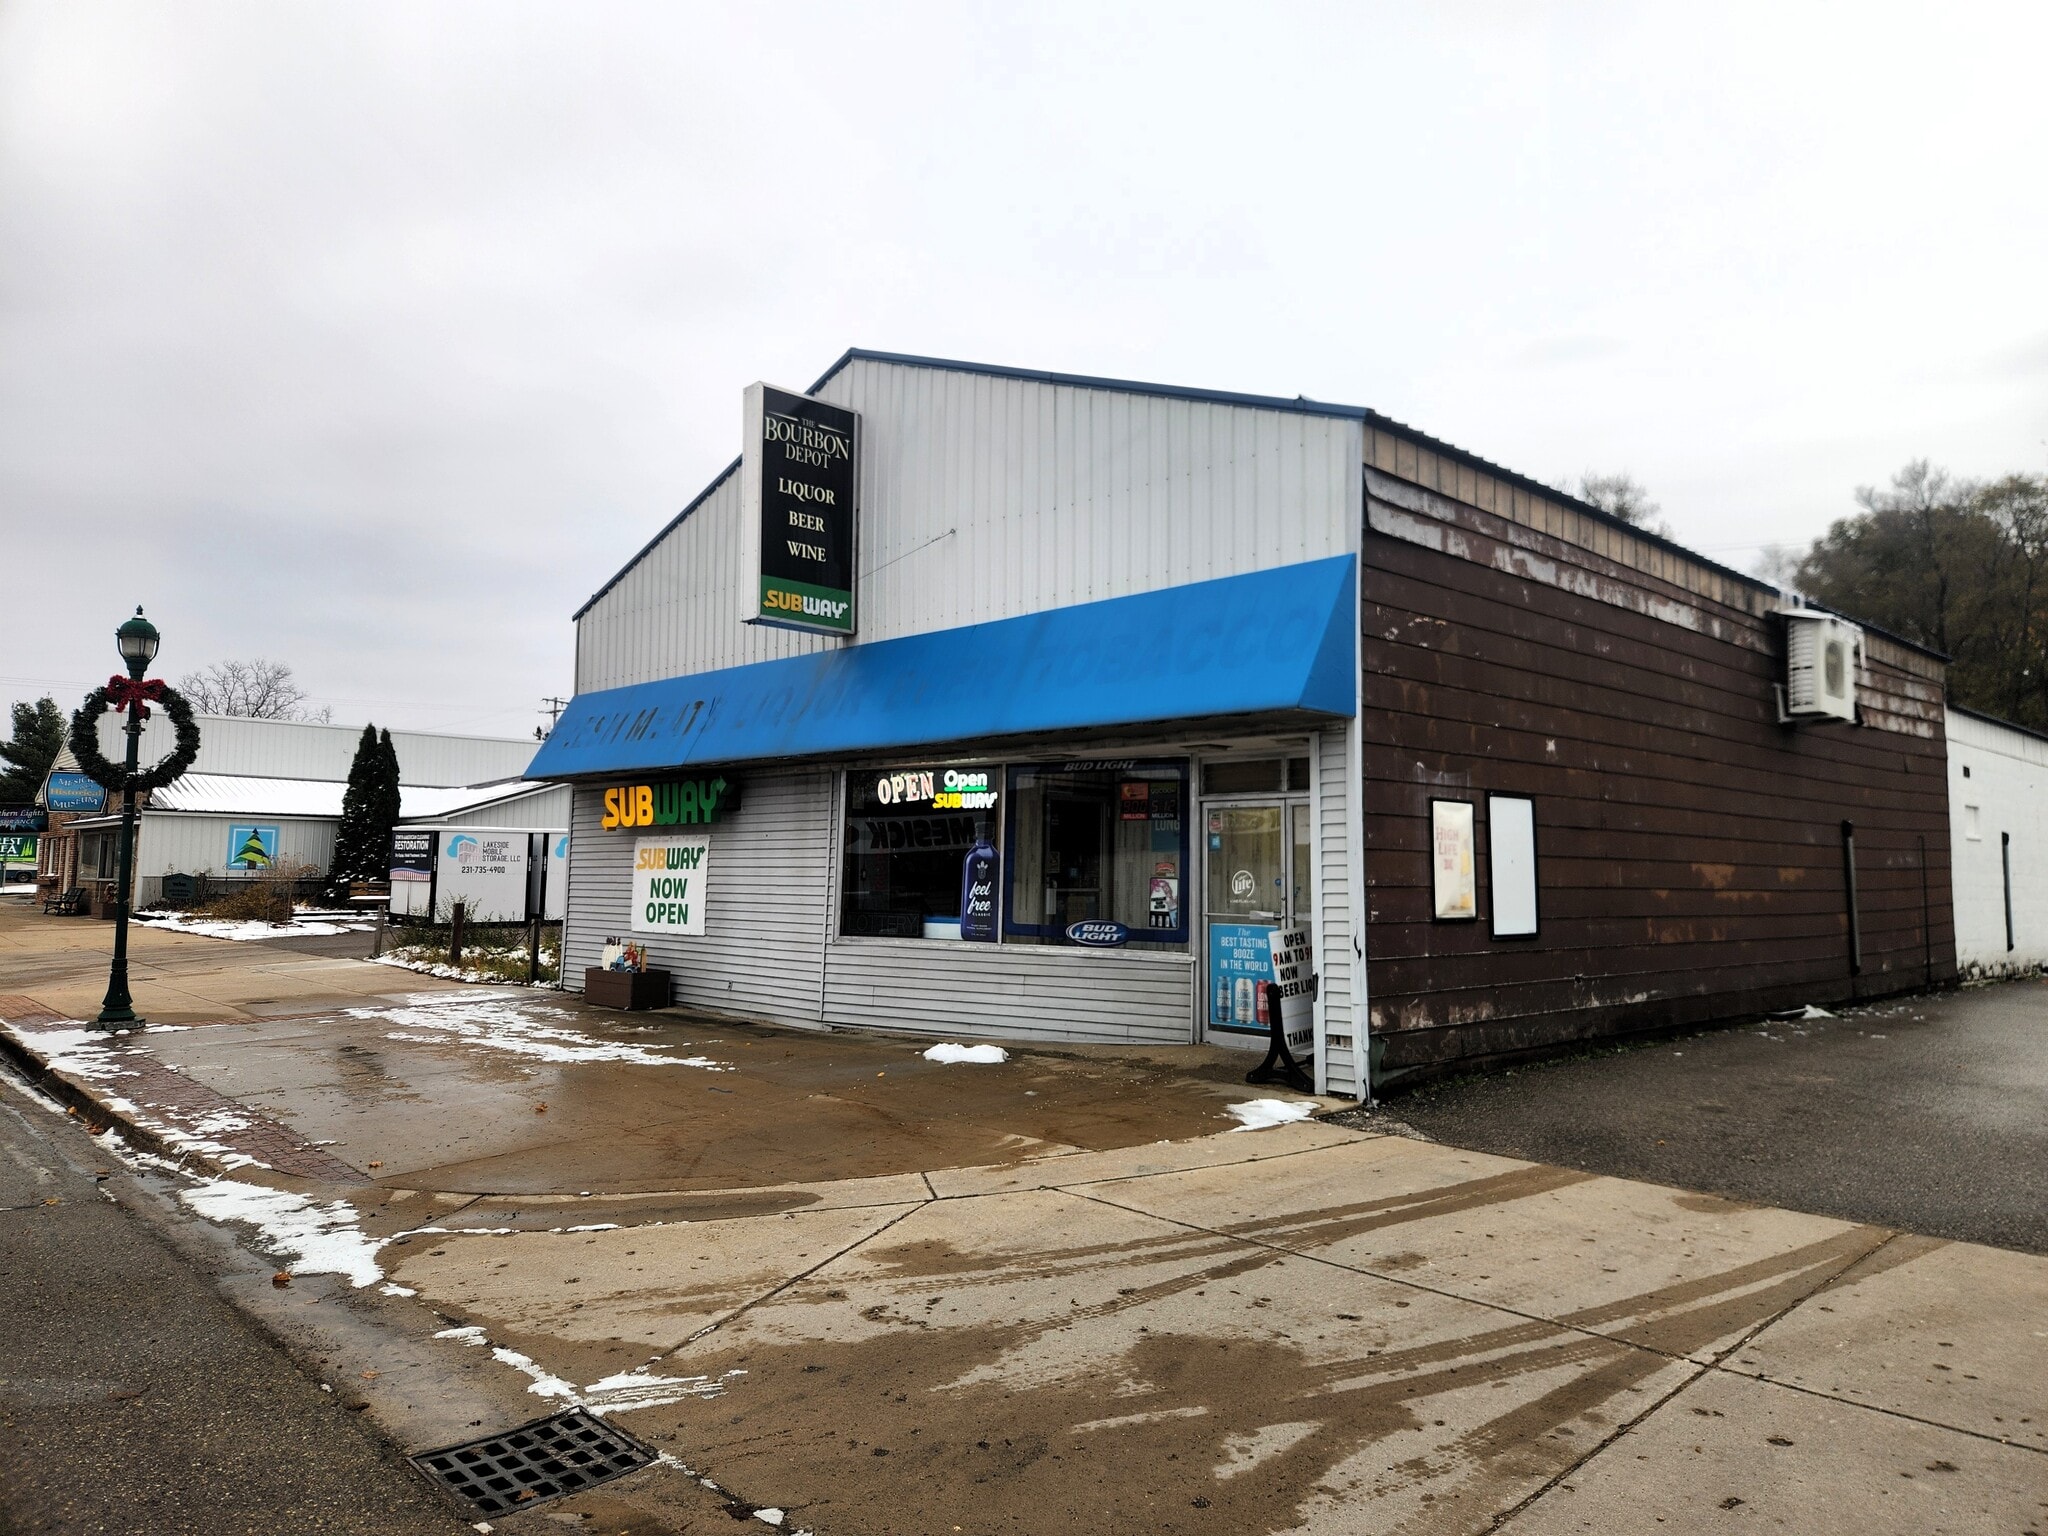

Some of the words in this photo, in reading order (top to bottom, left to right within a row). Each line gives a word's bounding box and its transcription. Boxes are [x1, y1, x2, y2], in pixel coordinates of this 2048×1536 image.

[801, 418, 816, 428] THE
[764, 416, 850, 461] BOURBON
[785, 443, 831, 469] DEPOT
[778, 478, 836, 505] LIQUOR
[789, 511, 825, 533] BEER
[787, 540, 827, 563] WINE
[763, 589, 849, 619] SUBWAY
[1064, 762, 1094, 771] BUD
[1095, 760, 1137, 770] LIGHT
[877, 771, 935, 805] OPEN
[944, 769, 988, 791] Open
[601, 776, 727, 831] SUBWAY
[932, 791, 998, 809] SUBWAY
[1435, 826, 1459, 841] HIGH
[1438, 842, 1458, 856] LIFE
[636, 845, 706, 872] SUBWAY
[650, 877, 688, 899] NOW
[969, 881, 991, 899] feel
[646, 902, 688, 925] OPEN
[848, 914, 918, 933] LOTTERY
[1081, 924, 1117, 934] BUD
[1237, 928, 1251, 936] The
[1074, 931, 1124, 943] LIGHT
[1221, 937, 1238, 947] BEST
[1239, 938, 1267, 949] TASTING
[1284, 932, 1306, 948] OPEN
[1233, 949, 1255, 960] BOOZE
[1220, 959, 1228, 969] IN
[1229, 959, 1242, 970] THE
[1244, 960, 1268, 972] WORLD
[1280, 966, 1298, 982] NOW
[1279, 981, 1300, 998] BEER
